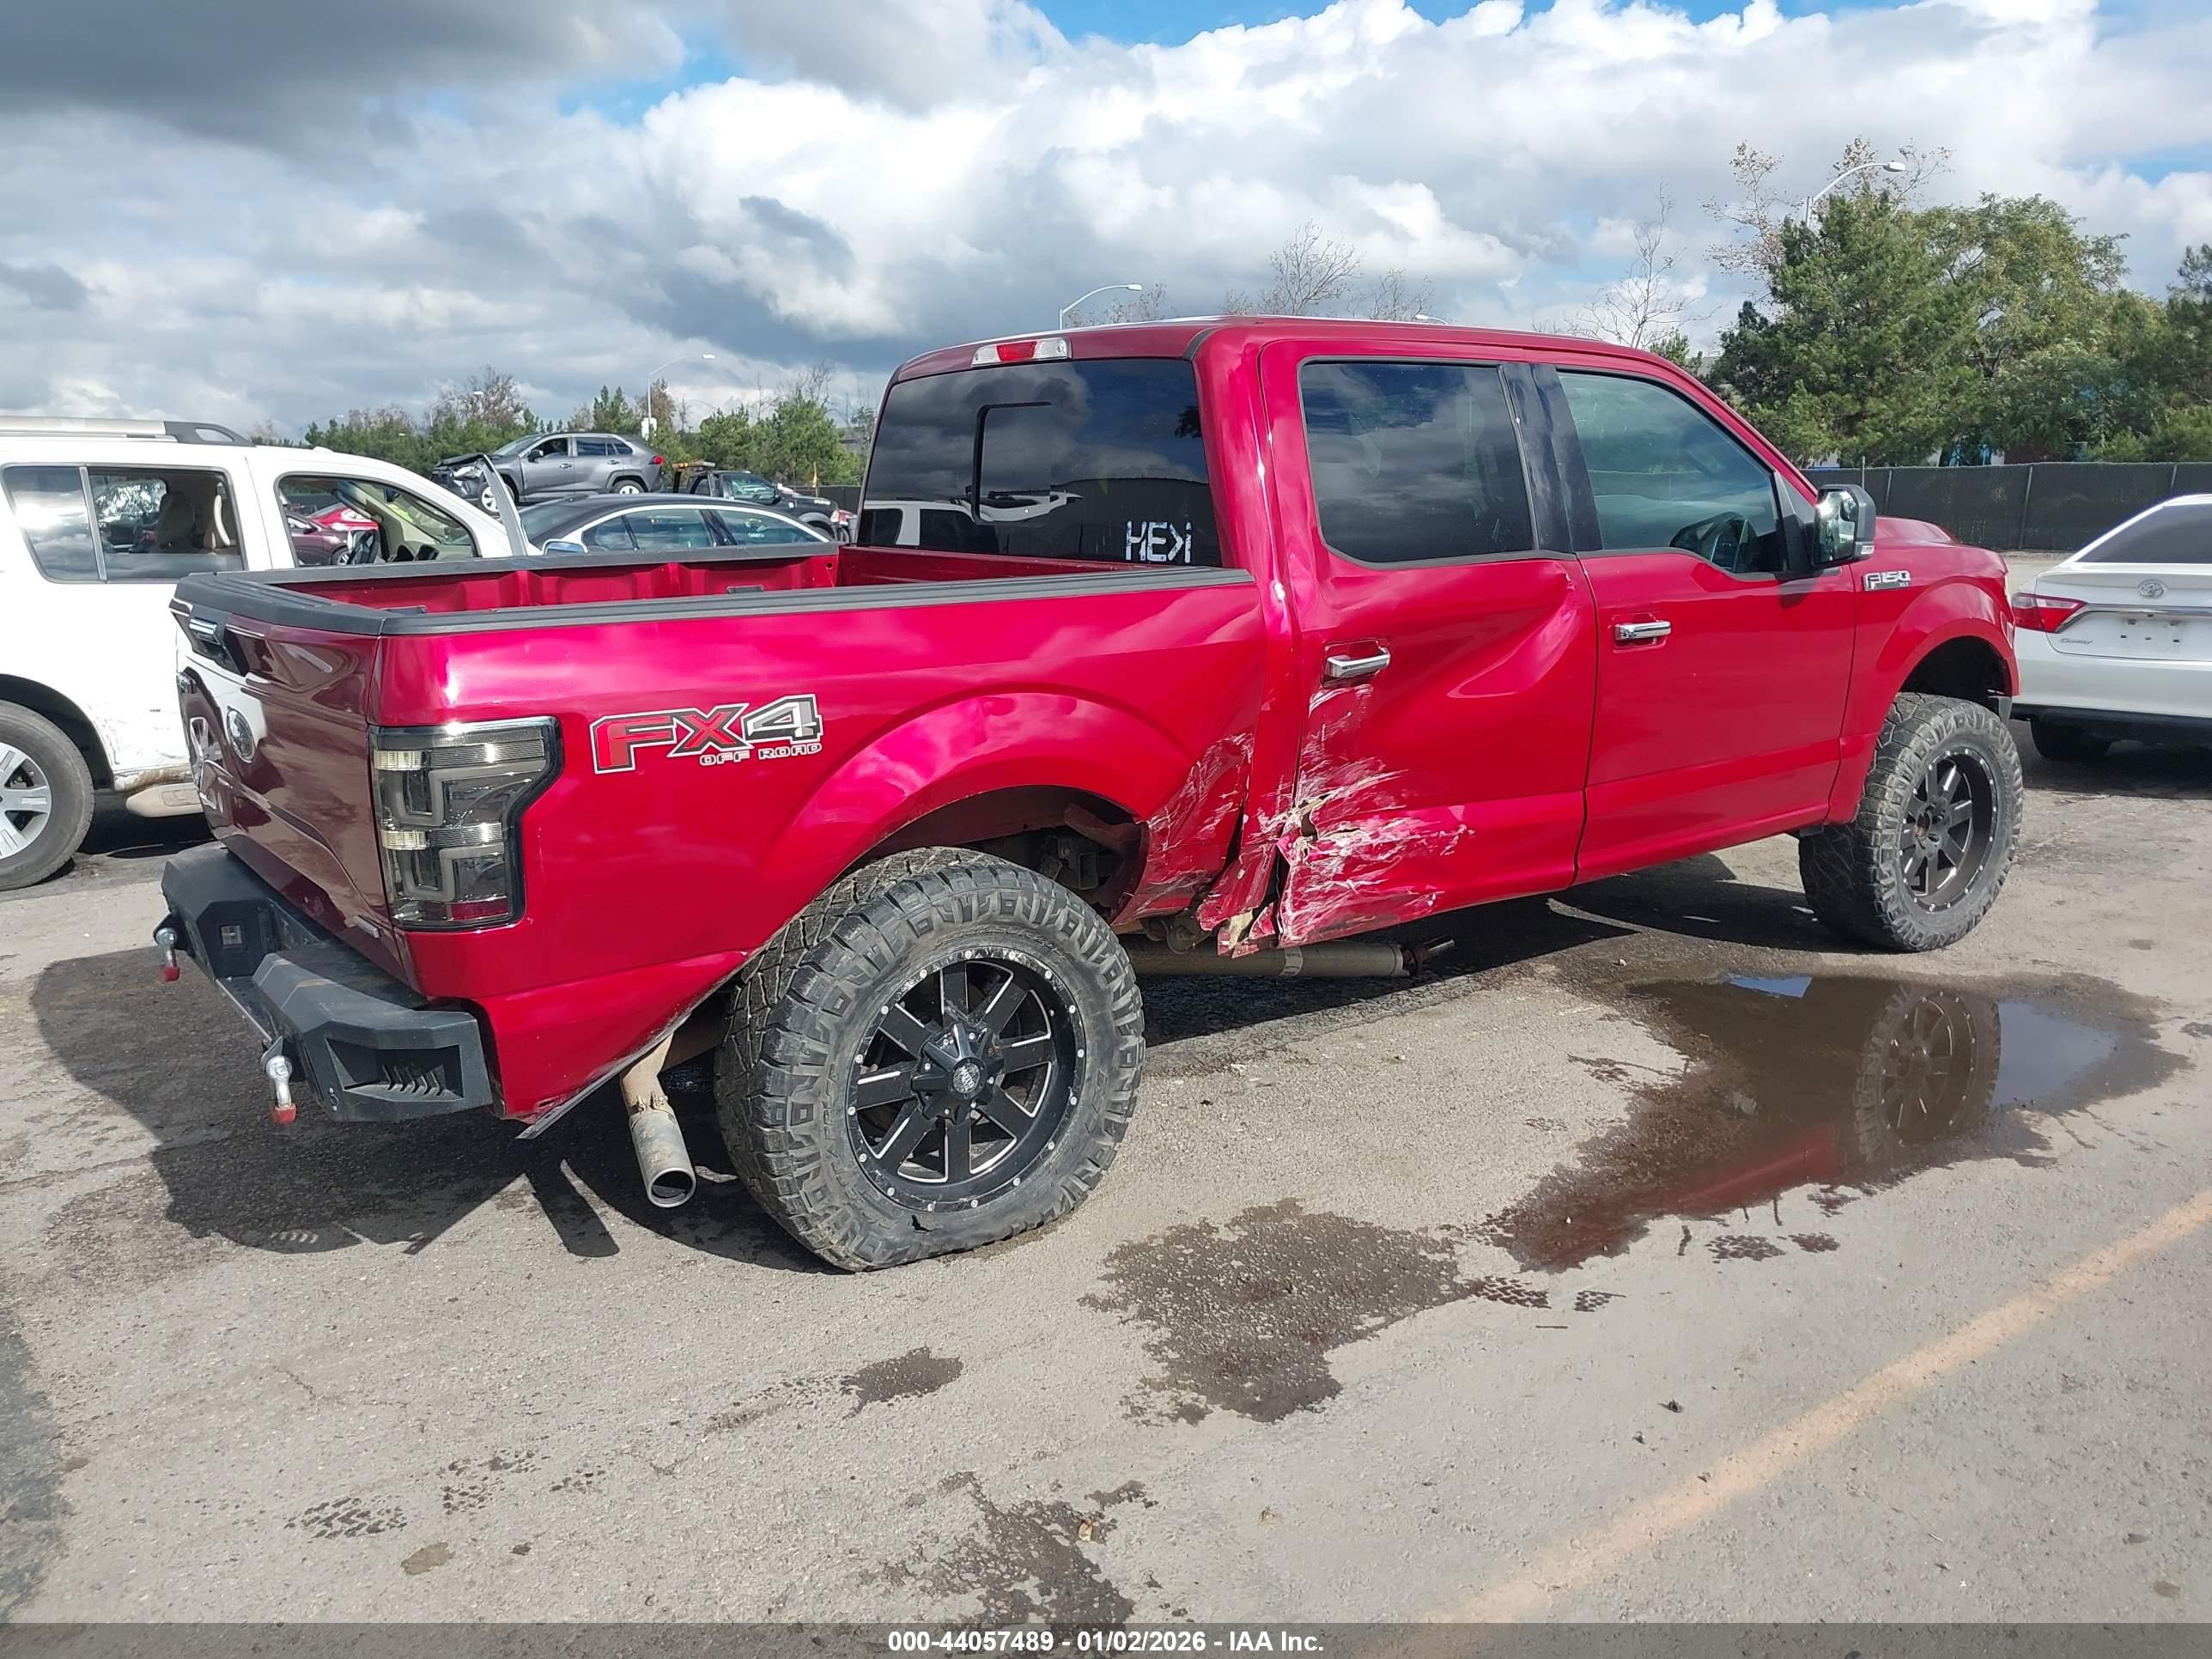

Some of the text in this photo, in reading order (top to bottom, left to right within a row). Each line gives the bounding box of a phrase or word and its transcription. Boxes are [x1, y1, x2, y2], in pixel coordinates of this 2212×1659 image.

[590, 694, 823, 774] FX4
[699, 742, 823, 766] OFF ROAD
